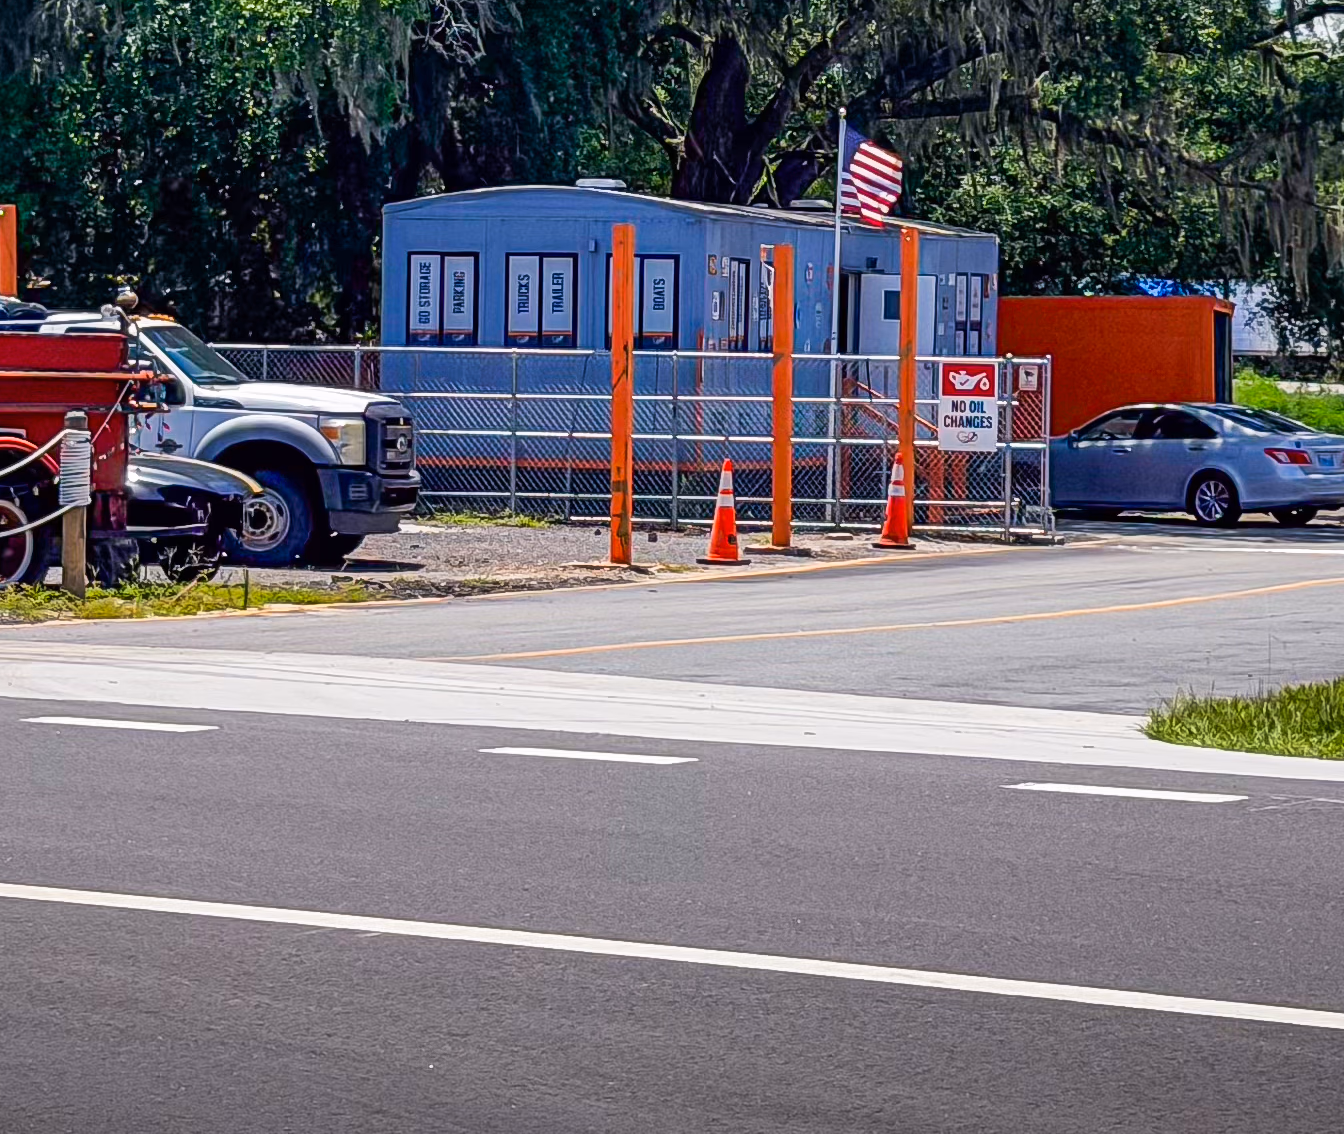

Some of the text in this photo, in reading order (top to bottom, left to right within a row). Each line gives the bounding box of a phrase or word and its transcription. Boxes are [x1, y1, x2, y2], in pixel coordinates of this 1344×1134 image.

[418, 261, 432, 325] GO STORAGE
[452, 271, 465, 314] PARKING
[517, 274, 531, 314] TRUCKS
[552, 272, 564, 314] TRAILER
[652, 278, 665, 311] BOATS
[943, 414, 993, 429] CHANGES
[951, 400, 987, 414] NO OIL
